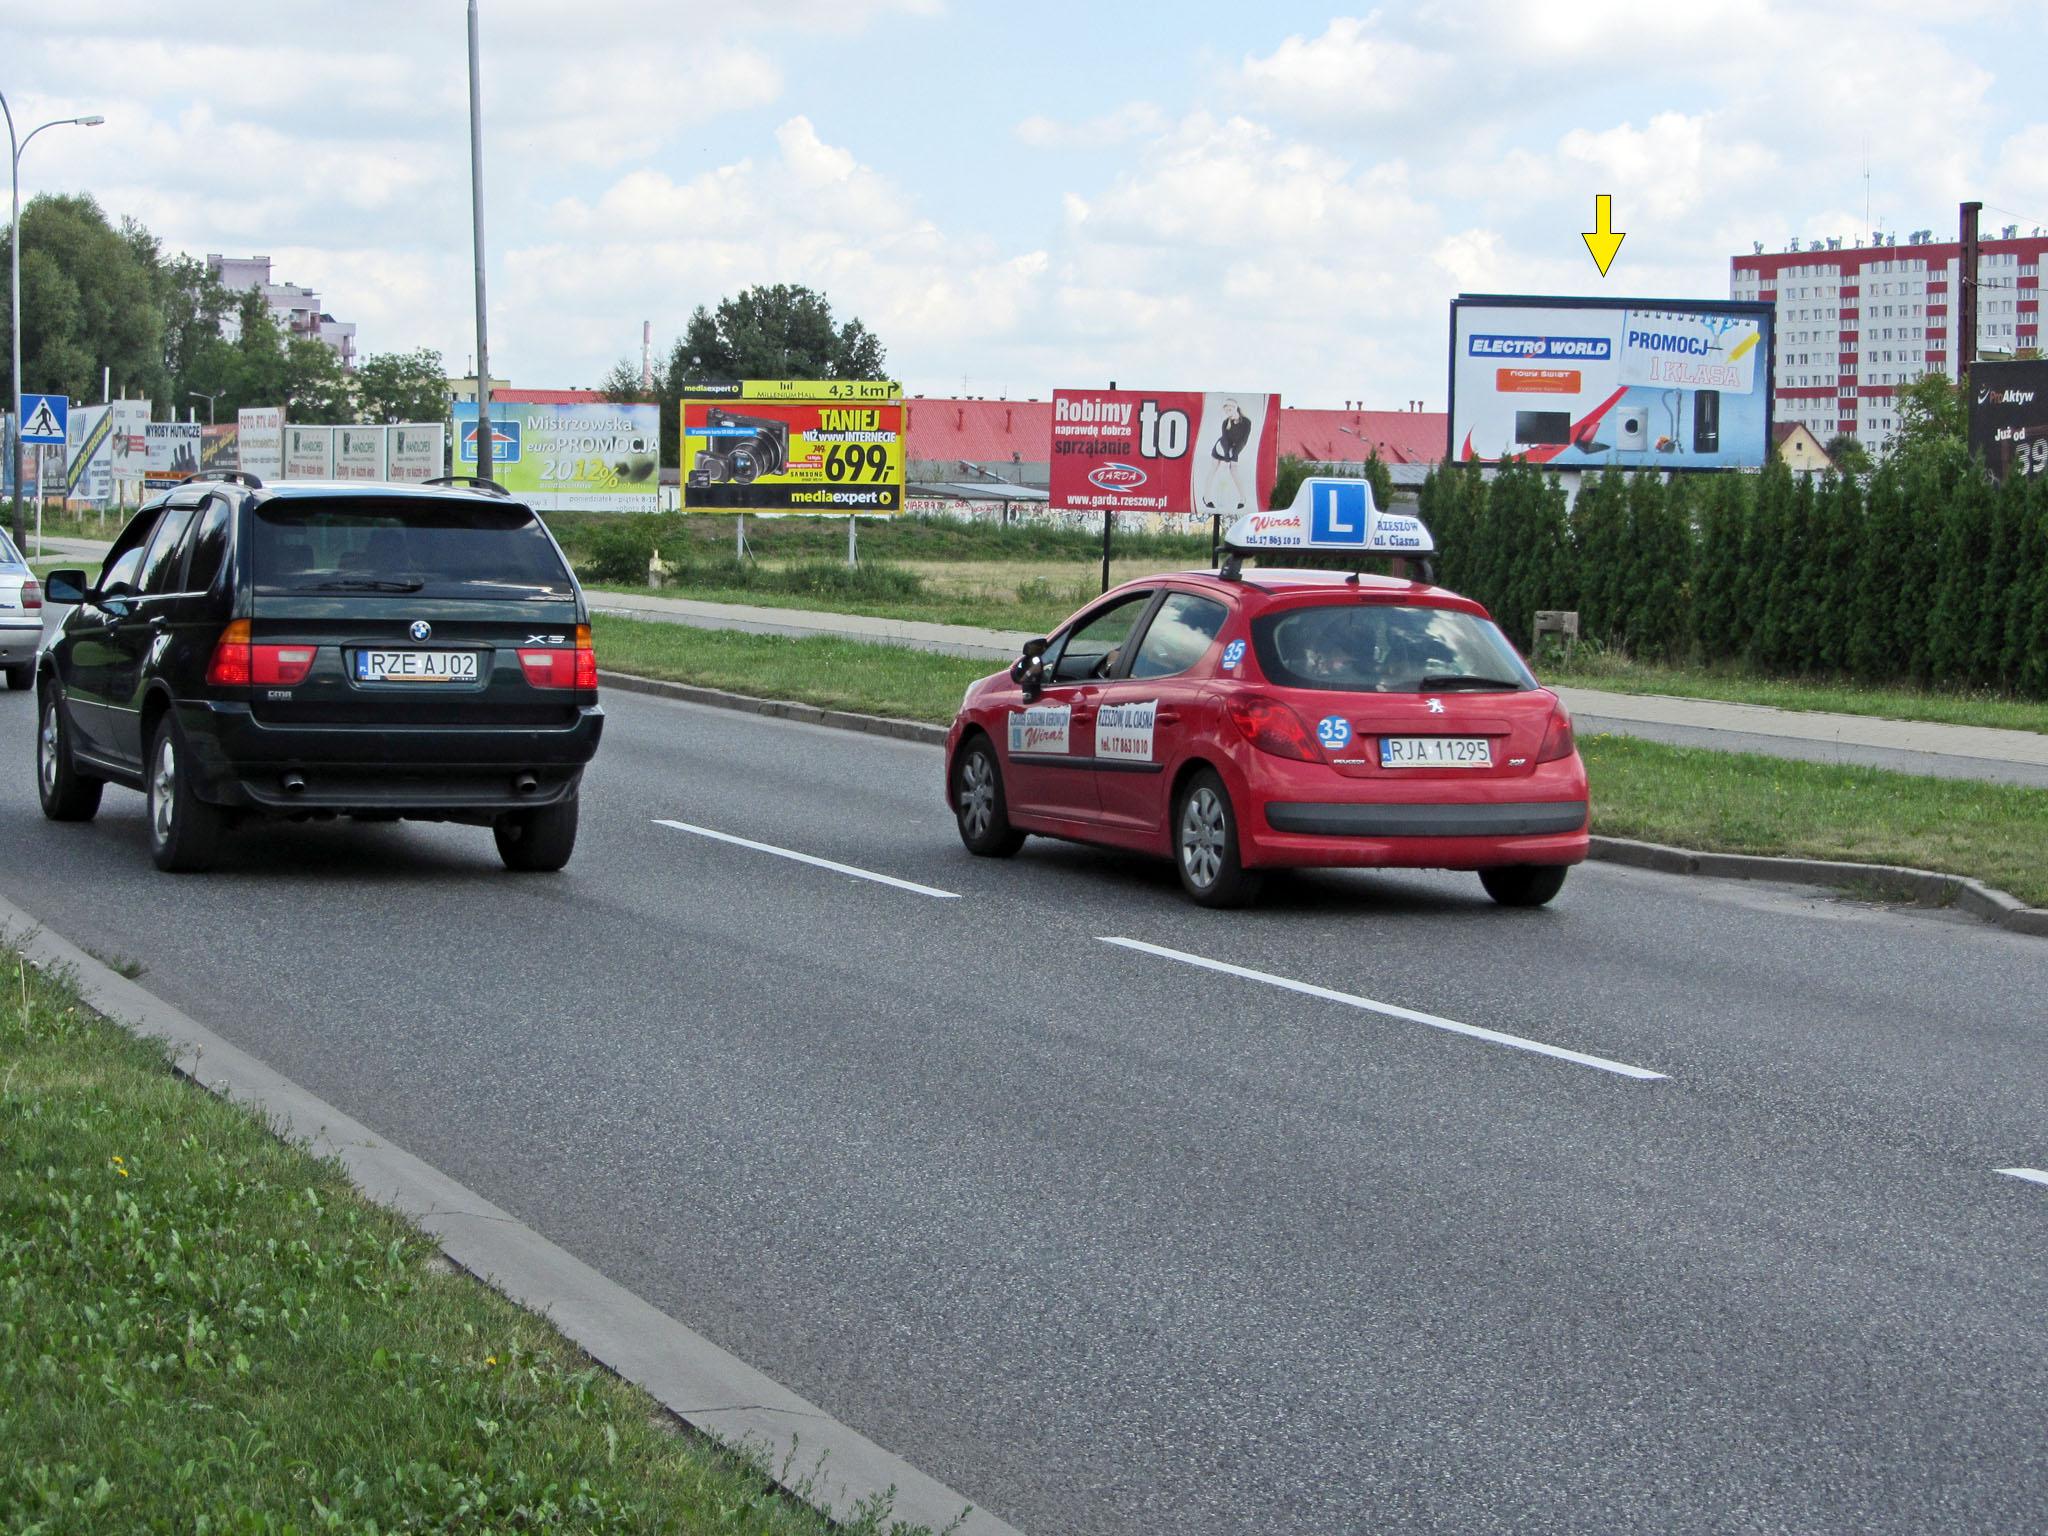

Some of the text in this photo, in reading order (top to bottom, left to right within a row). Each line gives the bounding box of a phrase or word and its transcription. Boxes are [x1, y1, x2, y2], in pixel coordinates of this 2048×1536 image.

[1472, 339, 1608, 355] ELECTRO WORLD
[1663, 361, 1741, 387] KLASA
[684, 384, 731, 393] mediaexpert
[829, 385, 884, 398] 4,3 km
[1989, 389, 2035, 406] ProAktyw
[818, 409, 881, 431] TANIEJ
[1055, 398, 1132, 426] Robimy
[527, 415, 634, 431] Mistrzowska
[1055, 425, 1132, 437] naprawdę dobrze
[1139, 400, 1189, 458] to
[145, 425, 169, 438] WYROBY
[170, 425, 200, 438] HUTNICZE
[802, 430, 897, 443] NIŻ www INTERNECIE
[1994, 426, 2026, 441] Już od
[1055, 438, 1131, 458] sprzątanie
[1097, 471, 1137, 482] GARDA
[791, 489, 877, 505] mediaexpert
[1067, 494, 1167, 510] www.garda.rzeszow.pl
[1328, 489, 1353, 532] L
[1250, 516, 1301, 532] Wiraż
[1377, 520, 1419, 532] RZESZÓW
[1246, 535, 1257, 545] tel.
[1258, 536, 1267, 545] 17
[1269, 536, 1282, 545] 863
[1283, 537, 1291, 545] 10
[1373, 534, 1420, 547] ul. Ciasna
[524, 634, 566, 644] X5
[1224, 643, 1246, 660] 35
[372, 653, 474, 675] RZE AJ02
[1319, 719, 1348, 740] 35
[1391, 740, 1488, 761] RJA 11295
